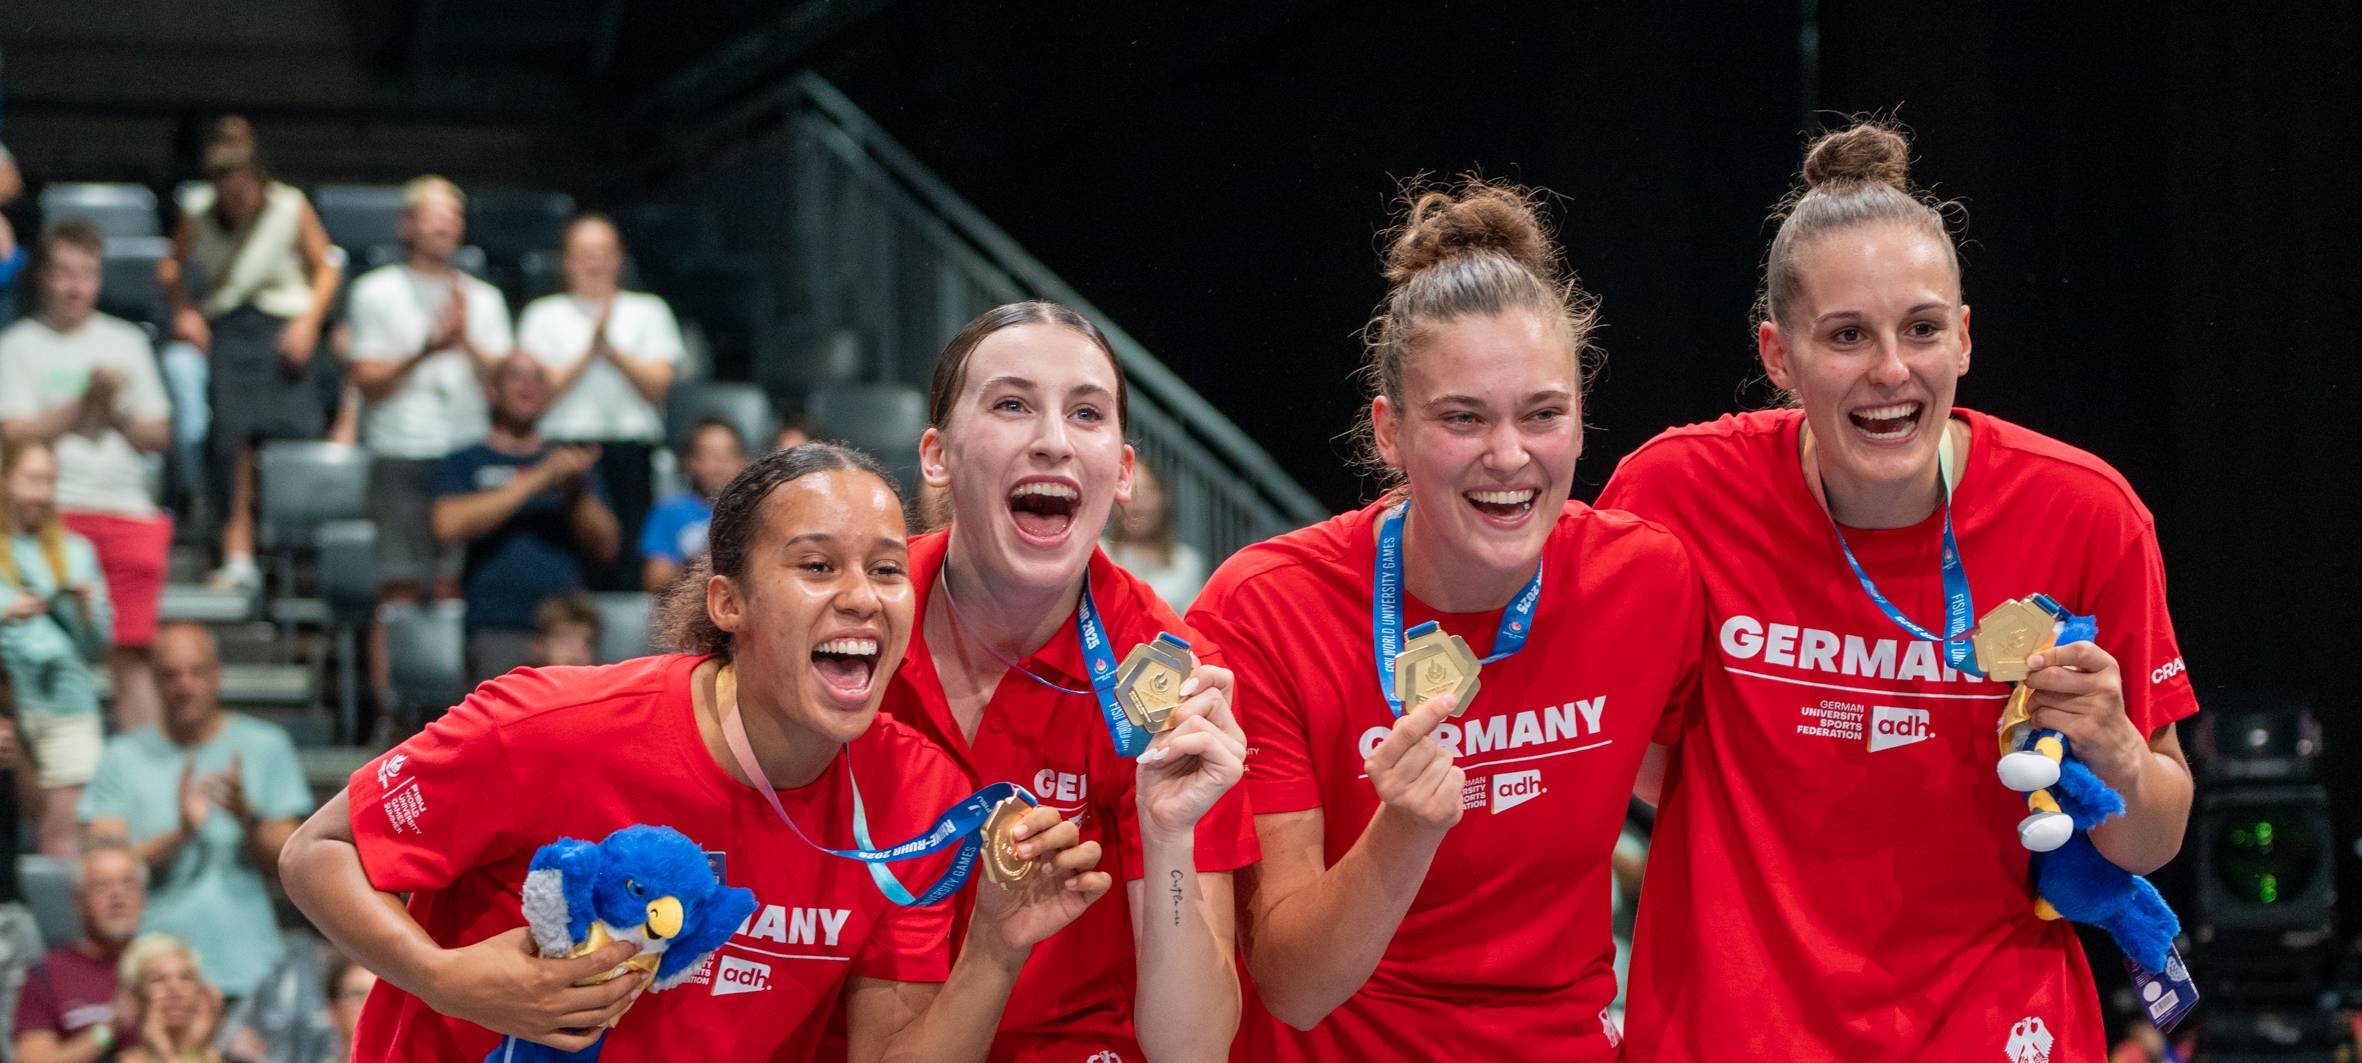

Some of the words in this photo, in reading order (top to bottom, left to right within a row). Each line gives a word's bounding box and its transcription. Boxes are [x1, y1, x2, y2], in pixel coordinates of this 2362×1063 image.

[1383, 536, 1396, 569] GAMES
[1381, 571, 1396, 627] UNIVERSITY
[1516, 584, 1541, 615] 2025
[1951, 593, 1966, 617] FISU
[1082, 620, 1101, 650] 2025
[1382, 628, 1396, 656] WORLD
[1108, 701, 1125, 722] FISU
[1801, 706, 1864, 721] UNIVERSITY
[1819, 700, 1865, 713] GERMAN
[1358, 695, 1607, 761] GRMANY
[1797, 725, 1862, 740] FEDERATION
[1819, 718, 1863, 731] SPORTS
[391, 797, 405, 825] GAMES
[398, 793, 423, 835] UNIVERSITY
[405, 788, 420, 818] WORLD
[383, 802, 403, 835] SUMMER
[893, 818, 957, 857] RHINE-RUHR
[952, 845, 978, 877] GAMES
